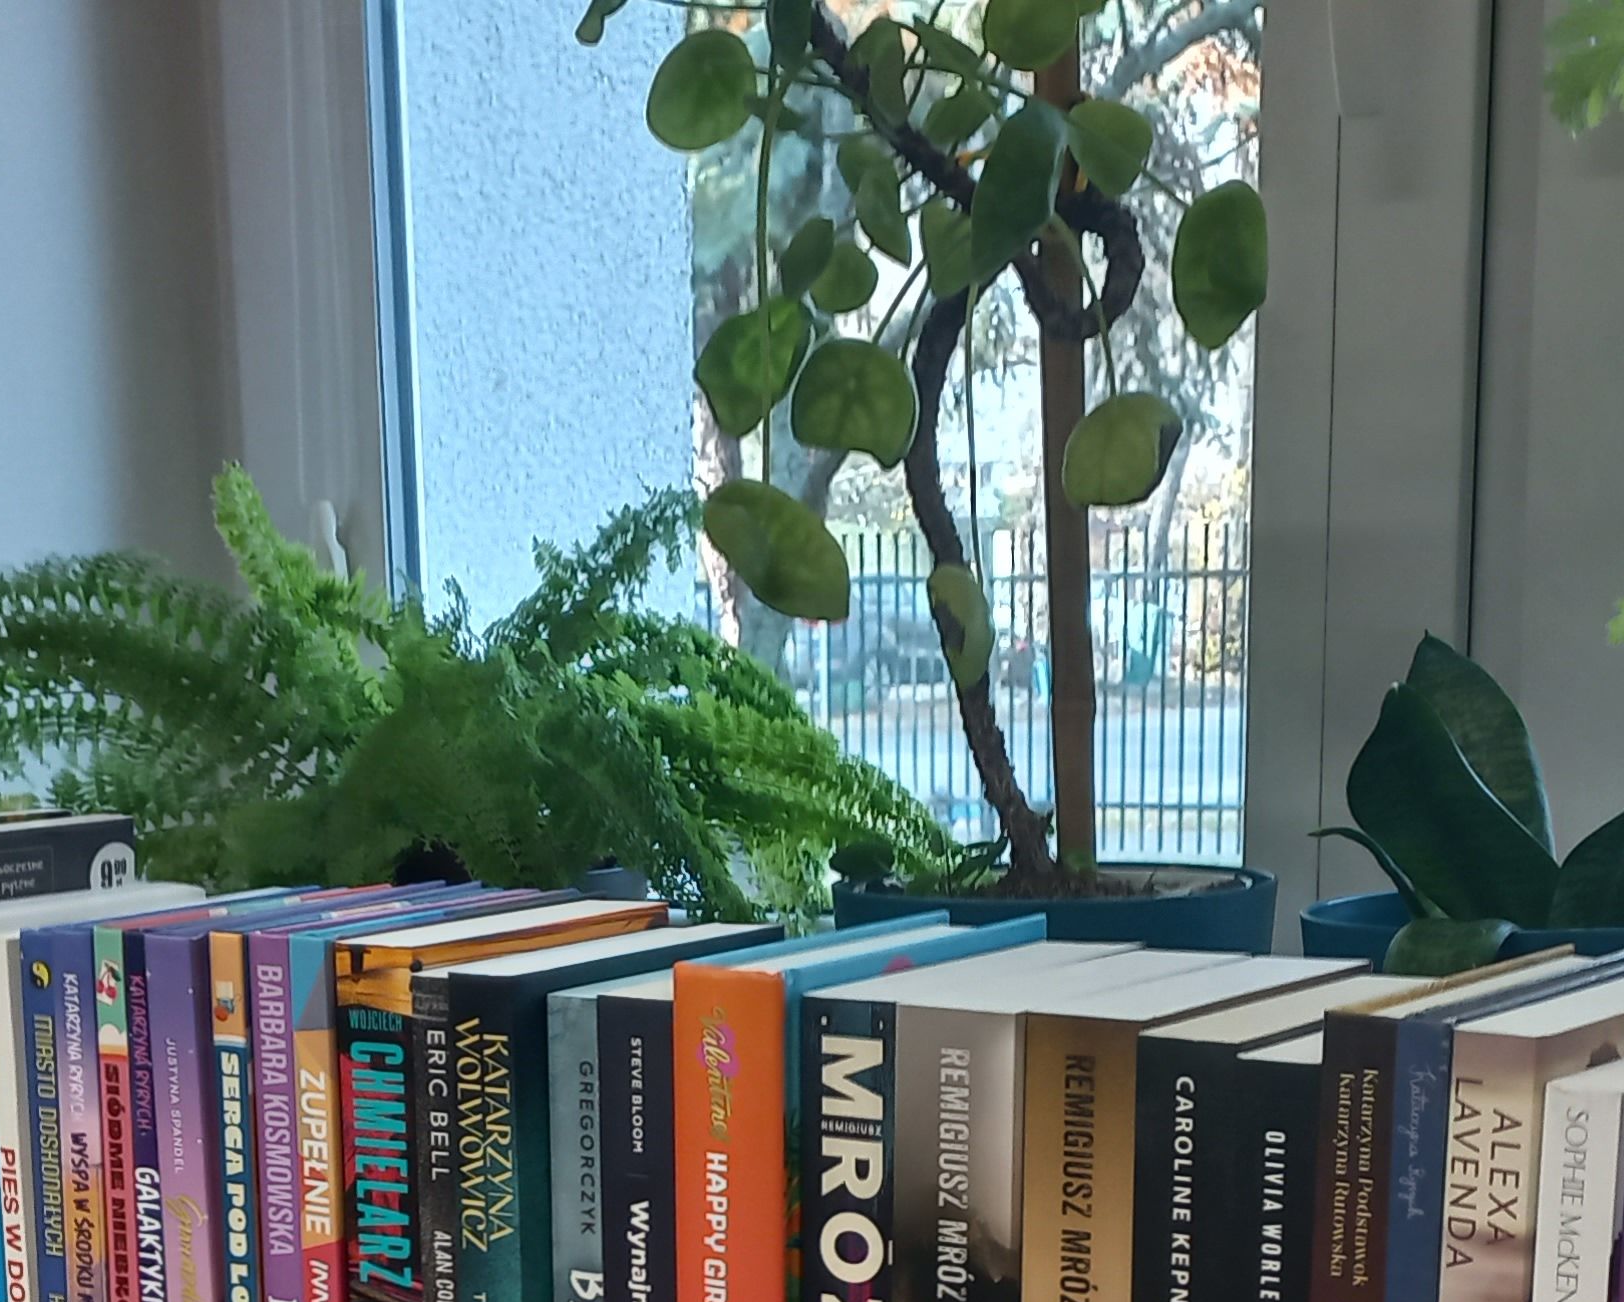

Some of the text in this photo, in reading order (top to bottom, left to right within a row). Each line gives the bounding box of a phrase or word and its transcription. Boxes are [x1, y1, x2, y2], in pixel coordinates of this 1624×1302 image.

[348, 1008, 403, 1033] WOJCIECH
[0, 1146, 20, 1216] PIES
[256, 963, 295, 1256] BARBARA KOSMOWSKA
[299, 1067, 332, 1237] ZUPEŁNIE
[349, 1040, 413, 1288] CHMIELARZ
[426, 1029, 451, 1182] ERIC BELL
[482, 1032, 515, 1243] KATARZYNA
[578, 1060, 598, 1235] GREGORCZYK
[936, 1047, 975, 1302] REMIGIUSZ MRÓZ
[1061, 1054, 1096, 1218] REMIGIUSZ
[1171, 1075, 1196, 1223] CAROLINE
[1261, 1130, 1286, 1212] OLIVIA
[1444, 1075, 1484, 1270] LAVENDA
[1486, 1107, 1524, 1247] ALEXA
[703, 1150, 729, 1253] HAPPY
